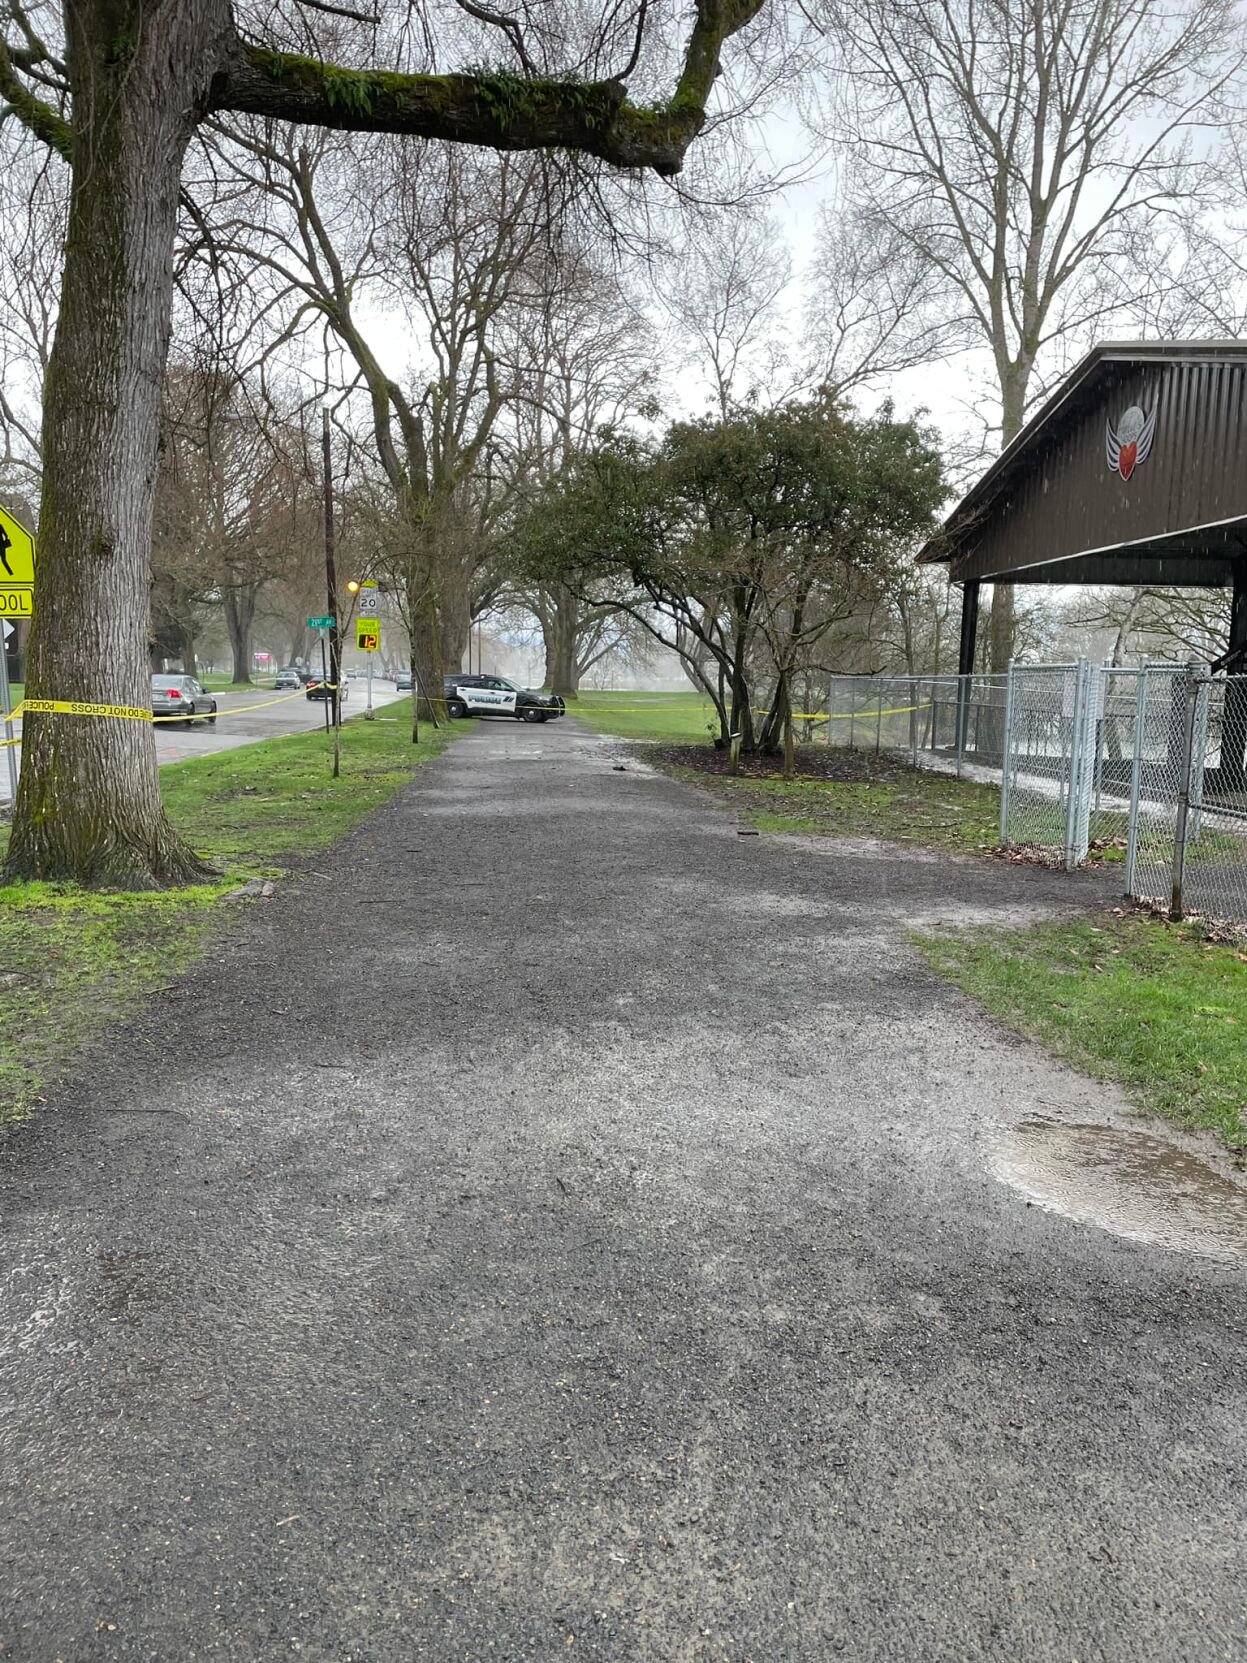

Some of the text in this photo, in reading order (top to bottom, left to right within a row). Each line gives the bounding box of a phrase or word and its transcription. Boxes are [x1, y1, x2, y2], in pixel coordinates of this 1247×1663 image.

[361, 598, 376, 608] 20
[364, 635, 377, 648] 12
[29, 701, 55, 711] POLICE
[71, 703, 106, 714] CROSS
[108, 706, 126, 716] NOT
[128, 708, 139, 718] DO
